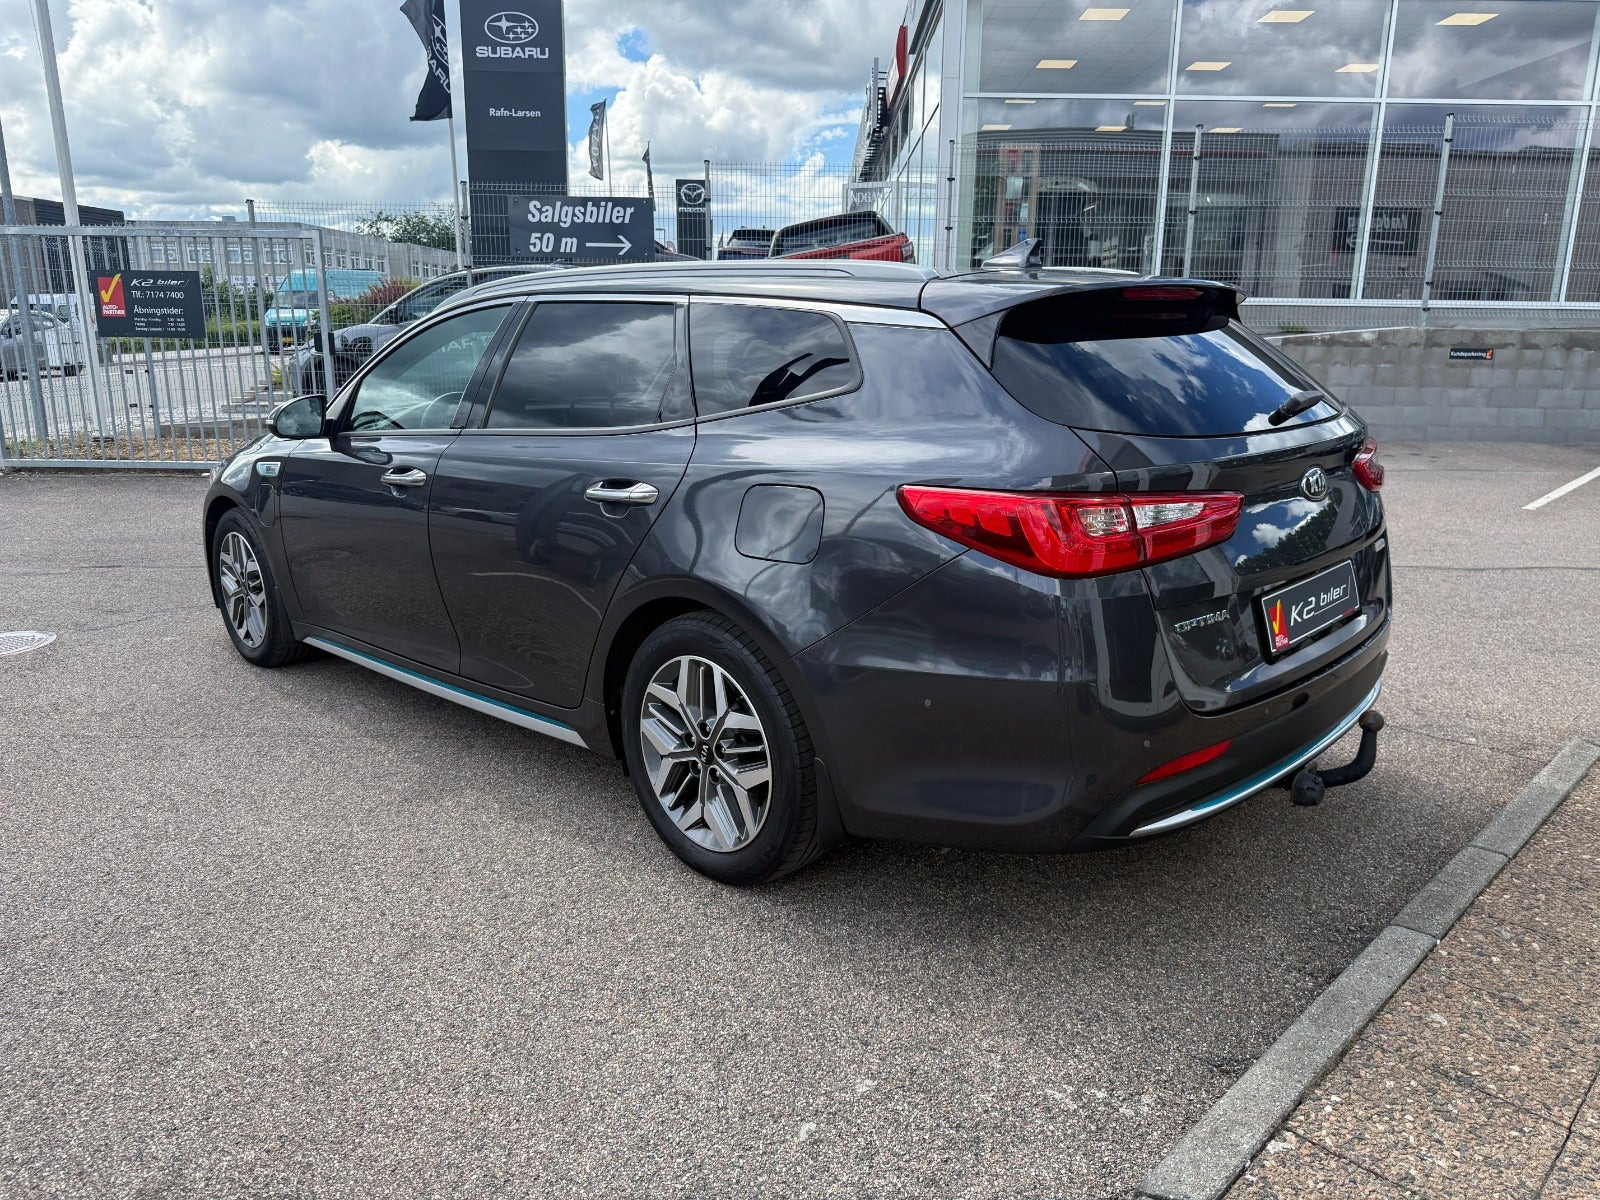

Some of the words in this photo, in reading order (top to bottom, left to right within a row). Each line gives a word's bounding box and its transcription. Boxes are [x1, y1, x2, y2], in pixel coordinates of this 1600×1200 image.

[475, 46, 549, 59] SUBARU
[427, 45, 451, 93] BARU
[489, 107, 541, 118] Rafn-Larsen
[527, 200, 635, 228] Salgsbiler
[529, 232, 555, 253] 50
[560, 237, 578, 253] m
[130, 278, 153, 287] K2
[146, 291, 164, 299] 7174
[165, 291, 185, 299] 7400
[133, 304, 184, 315] Åbningstider:
[1290, 596, 1316, 627] K2
[1320, 584, 1347, 606] biler
[1174, 609, 1230, 632] OPTIMA
